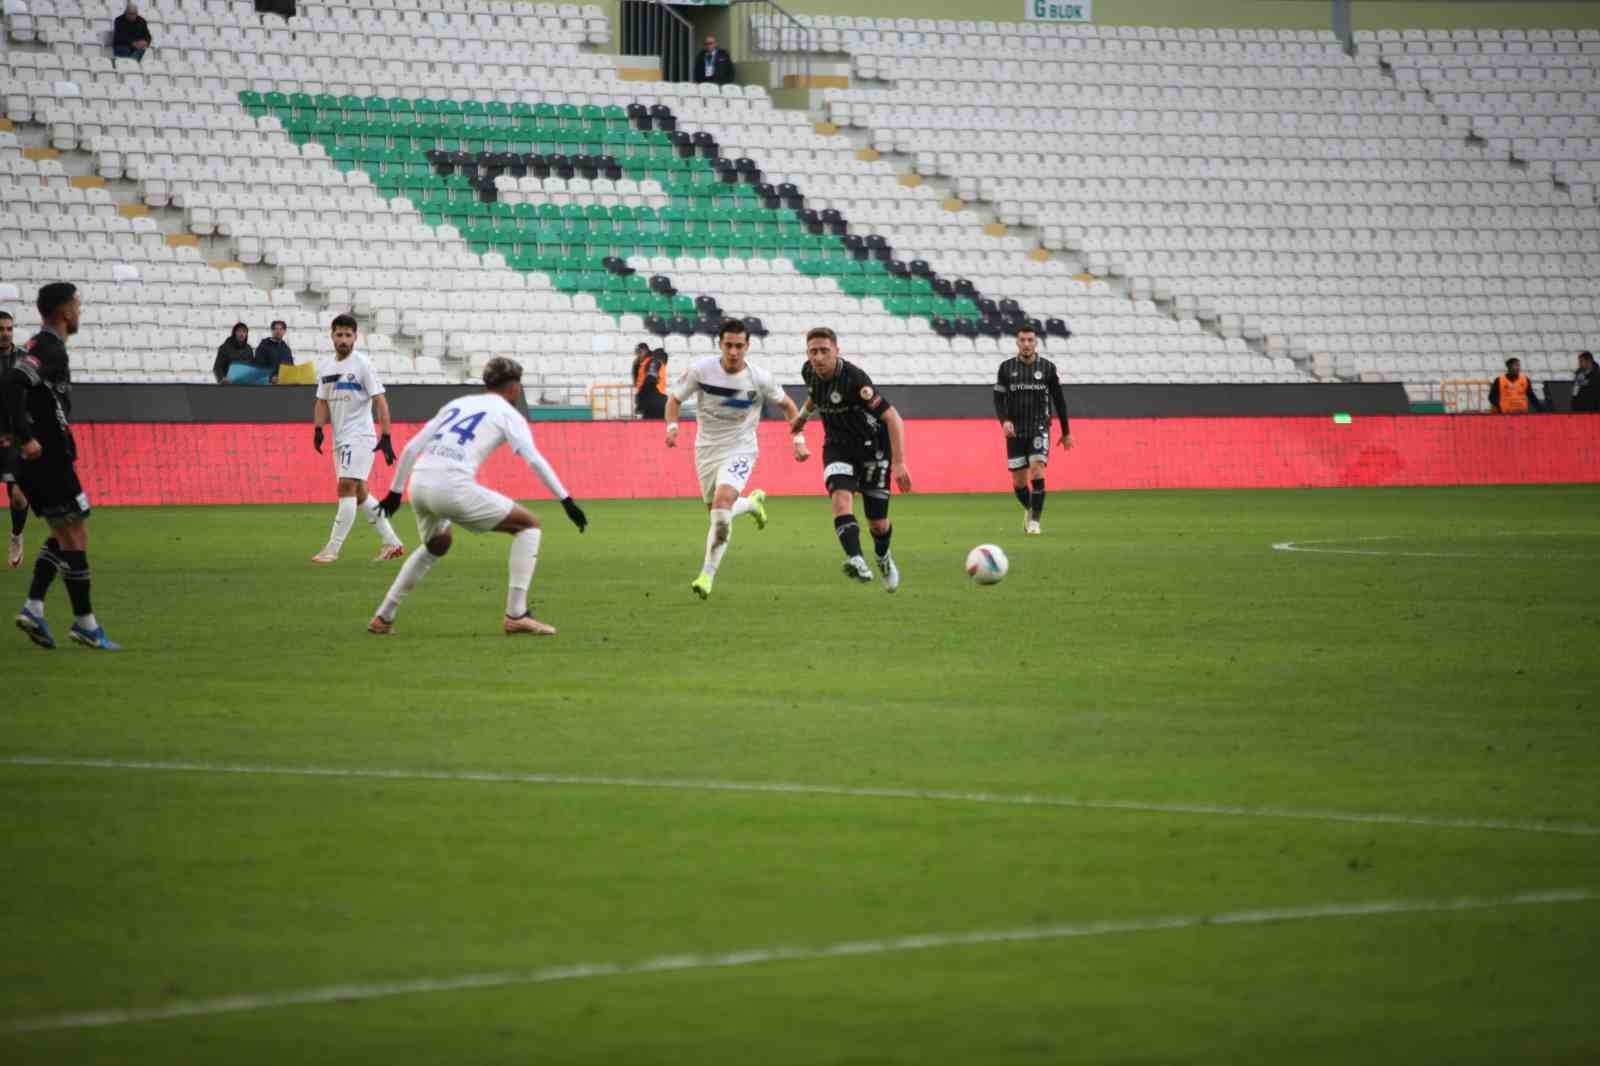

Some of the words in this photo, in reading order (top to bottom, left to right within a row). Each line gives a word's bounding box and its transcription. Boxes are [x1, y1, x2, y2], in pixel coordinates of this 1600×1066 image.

[1035, 0, 1046, 17] G
[1050, 4, 1082, 18] BLOK
[428, 407, 487, 445] 24
